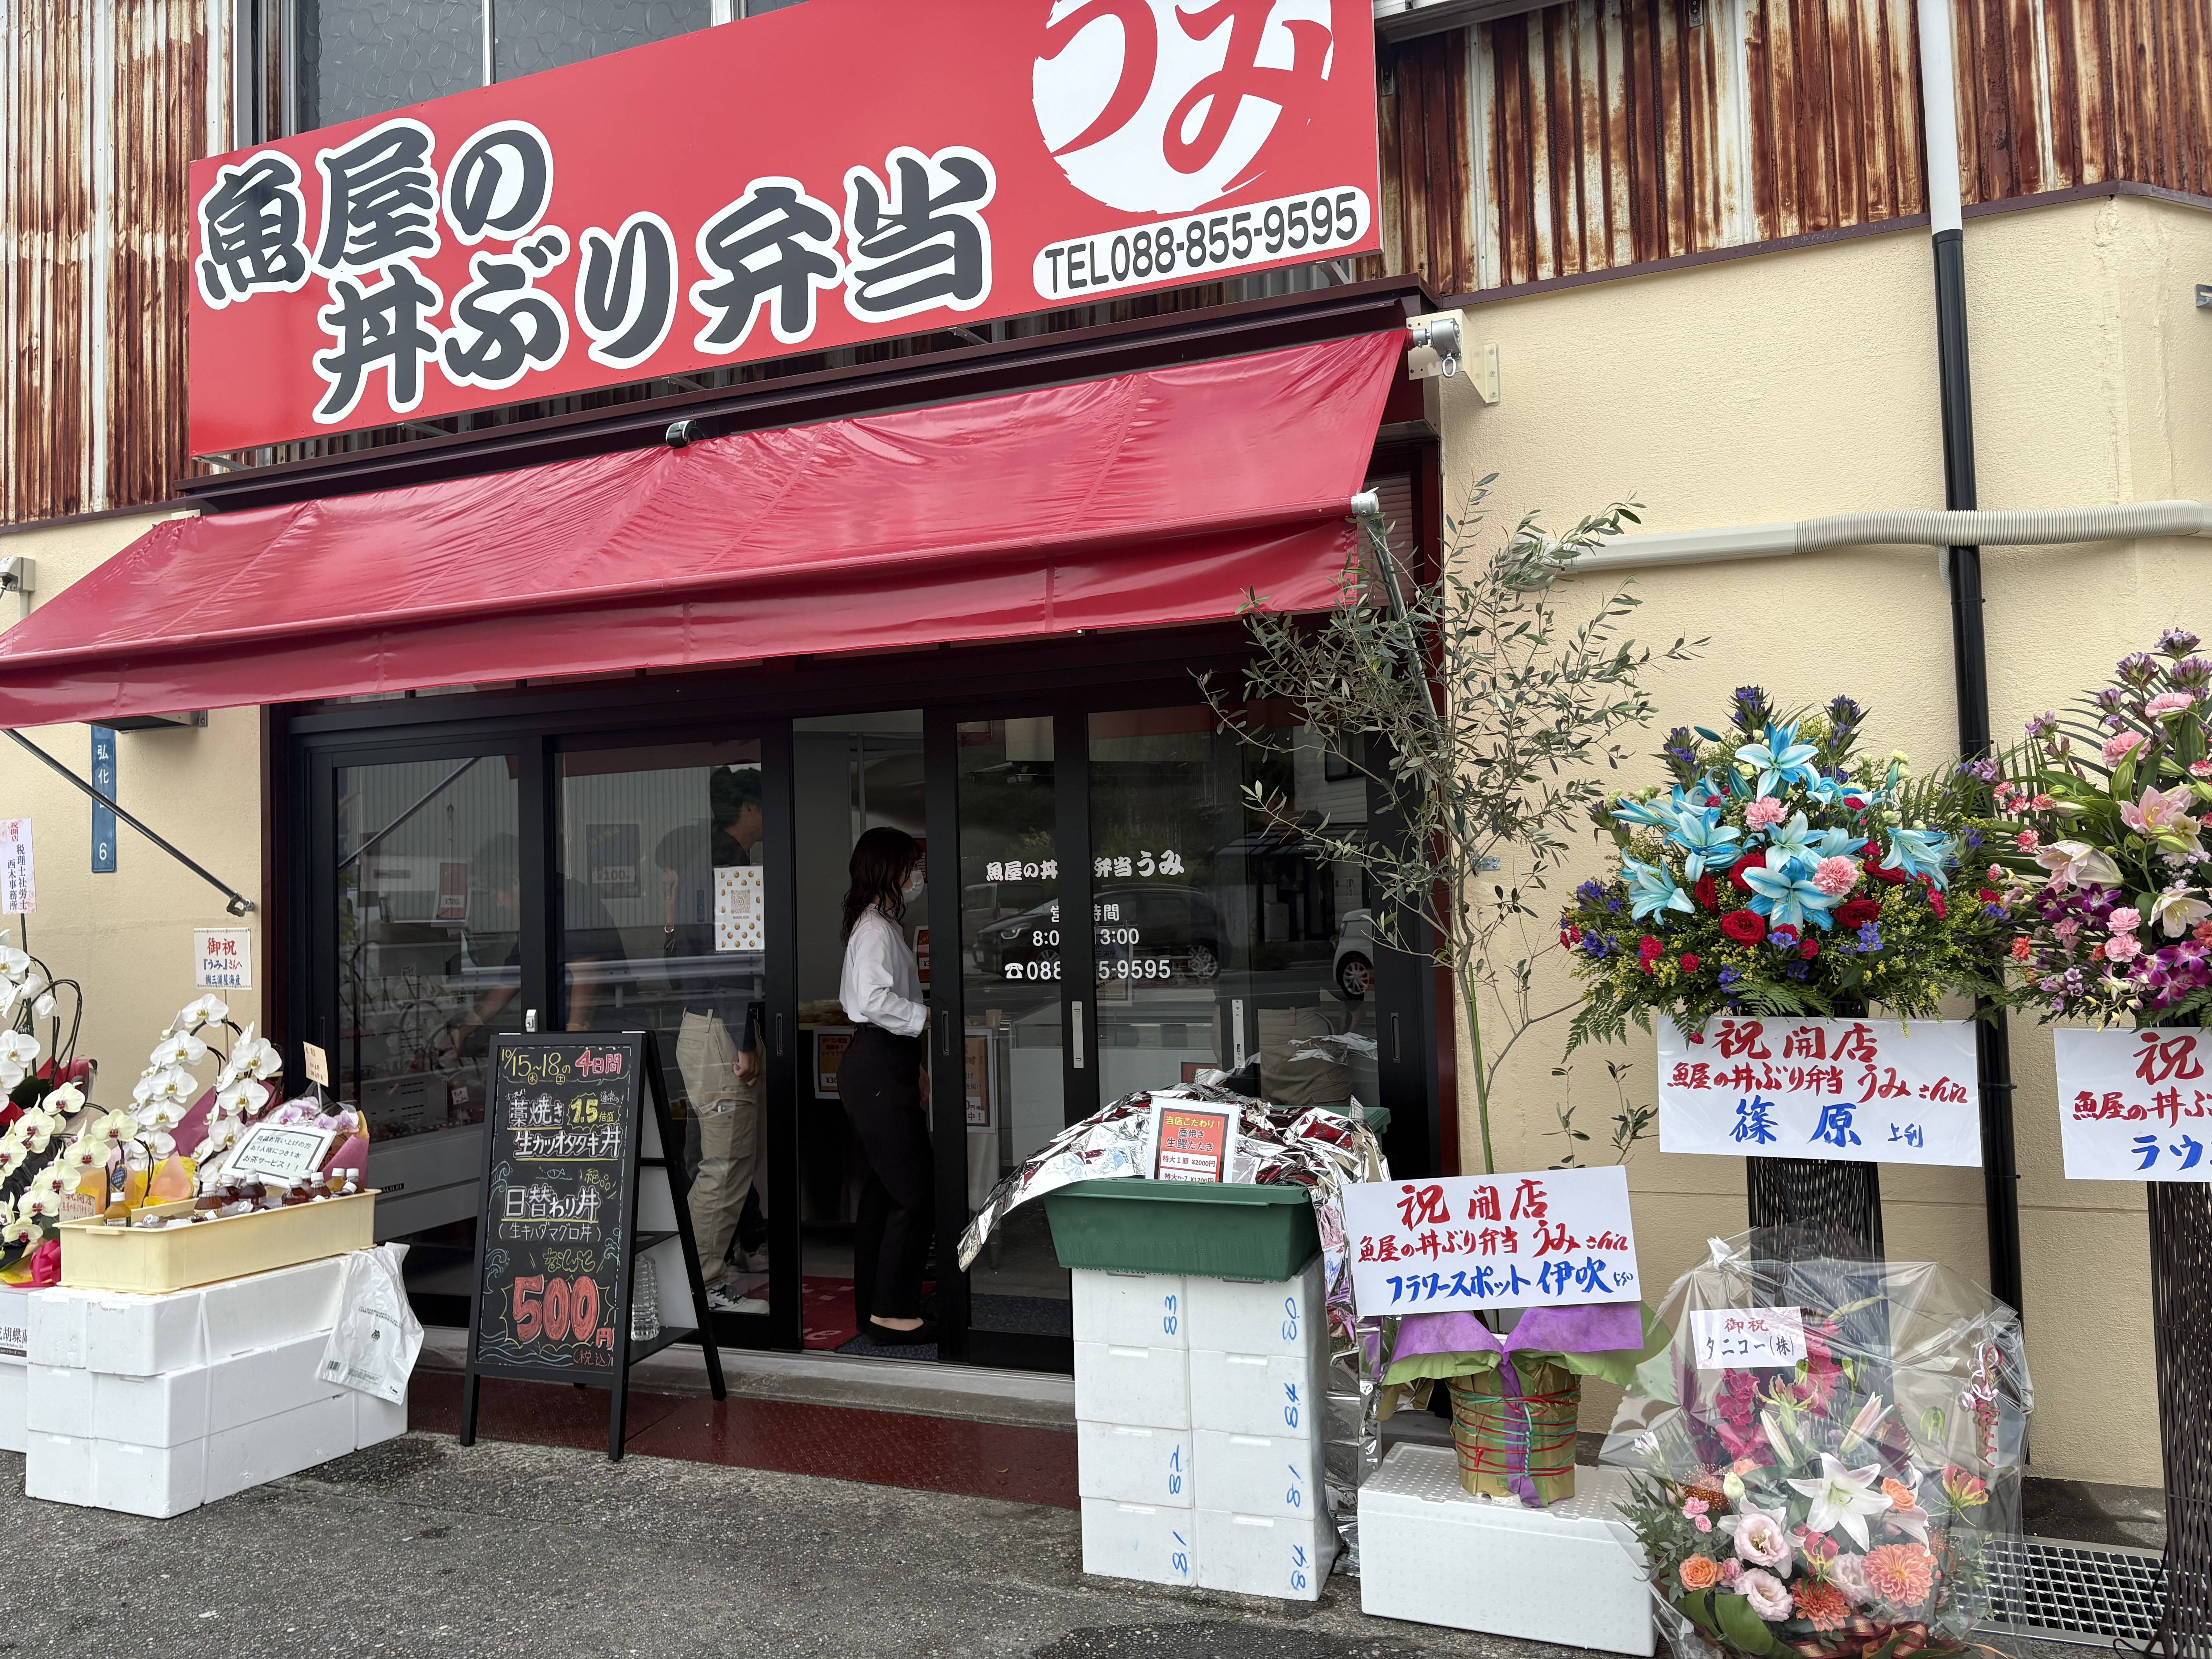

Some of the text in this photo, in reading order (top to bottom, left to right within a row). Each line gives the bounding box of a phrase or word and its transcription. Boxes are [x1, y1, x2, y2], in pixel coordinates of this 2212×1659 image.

[199, 119, 552, 307] 魚屋の
[316, 147, 995, 422] 丼ぶり弁当
[99, 842, 107, 860] 6
[986, 850, 1185, 881] 魚屋の丼弁当うみ
[207, 937, 237, 957] 御祝
[2133, 1032, 2204, 1085] 祝
[2131, 1135, 2212, 1171] ラウ
[506, 1185, 599, 1221] 日替わり丼
[0, 1326, 27, 1344] 胡蝶
[1724, 1317, 1769, 1334] 御祝
